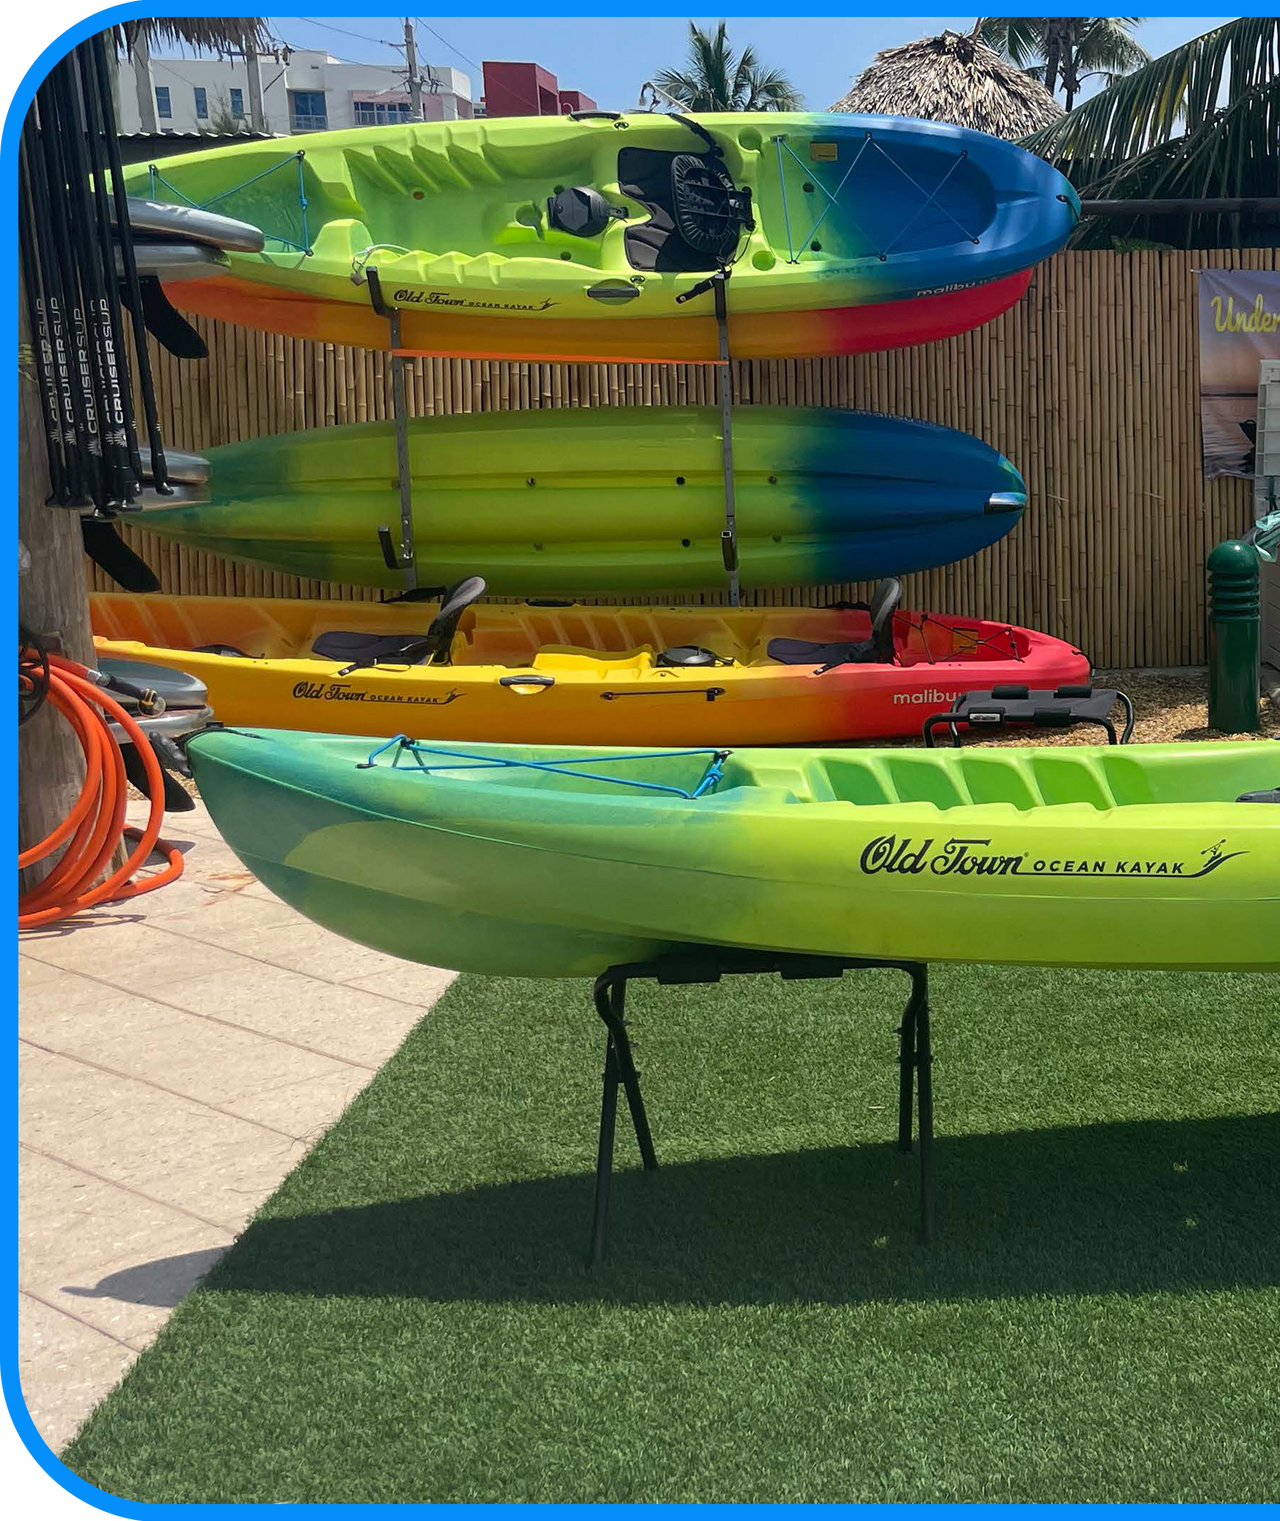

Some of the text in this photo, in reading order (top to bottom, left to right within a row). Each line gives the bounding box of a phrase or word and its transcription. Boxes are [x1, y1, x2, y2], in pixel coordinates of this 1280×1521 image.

[394, 289, 424, 304] Old
[424, 292, 465, 307] Town
[468, 301, 501, 309] OCEAN
[917, 281, 976, 298] malibu
[292, 681, 438, 704] Old Town OCEAN KAYAK
[893, 688, 957, 705] malibu
[859, 833, 1186, 876] Old Town OCEAN KAYAK
